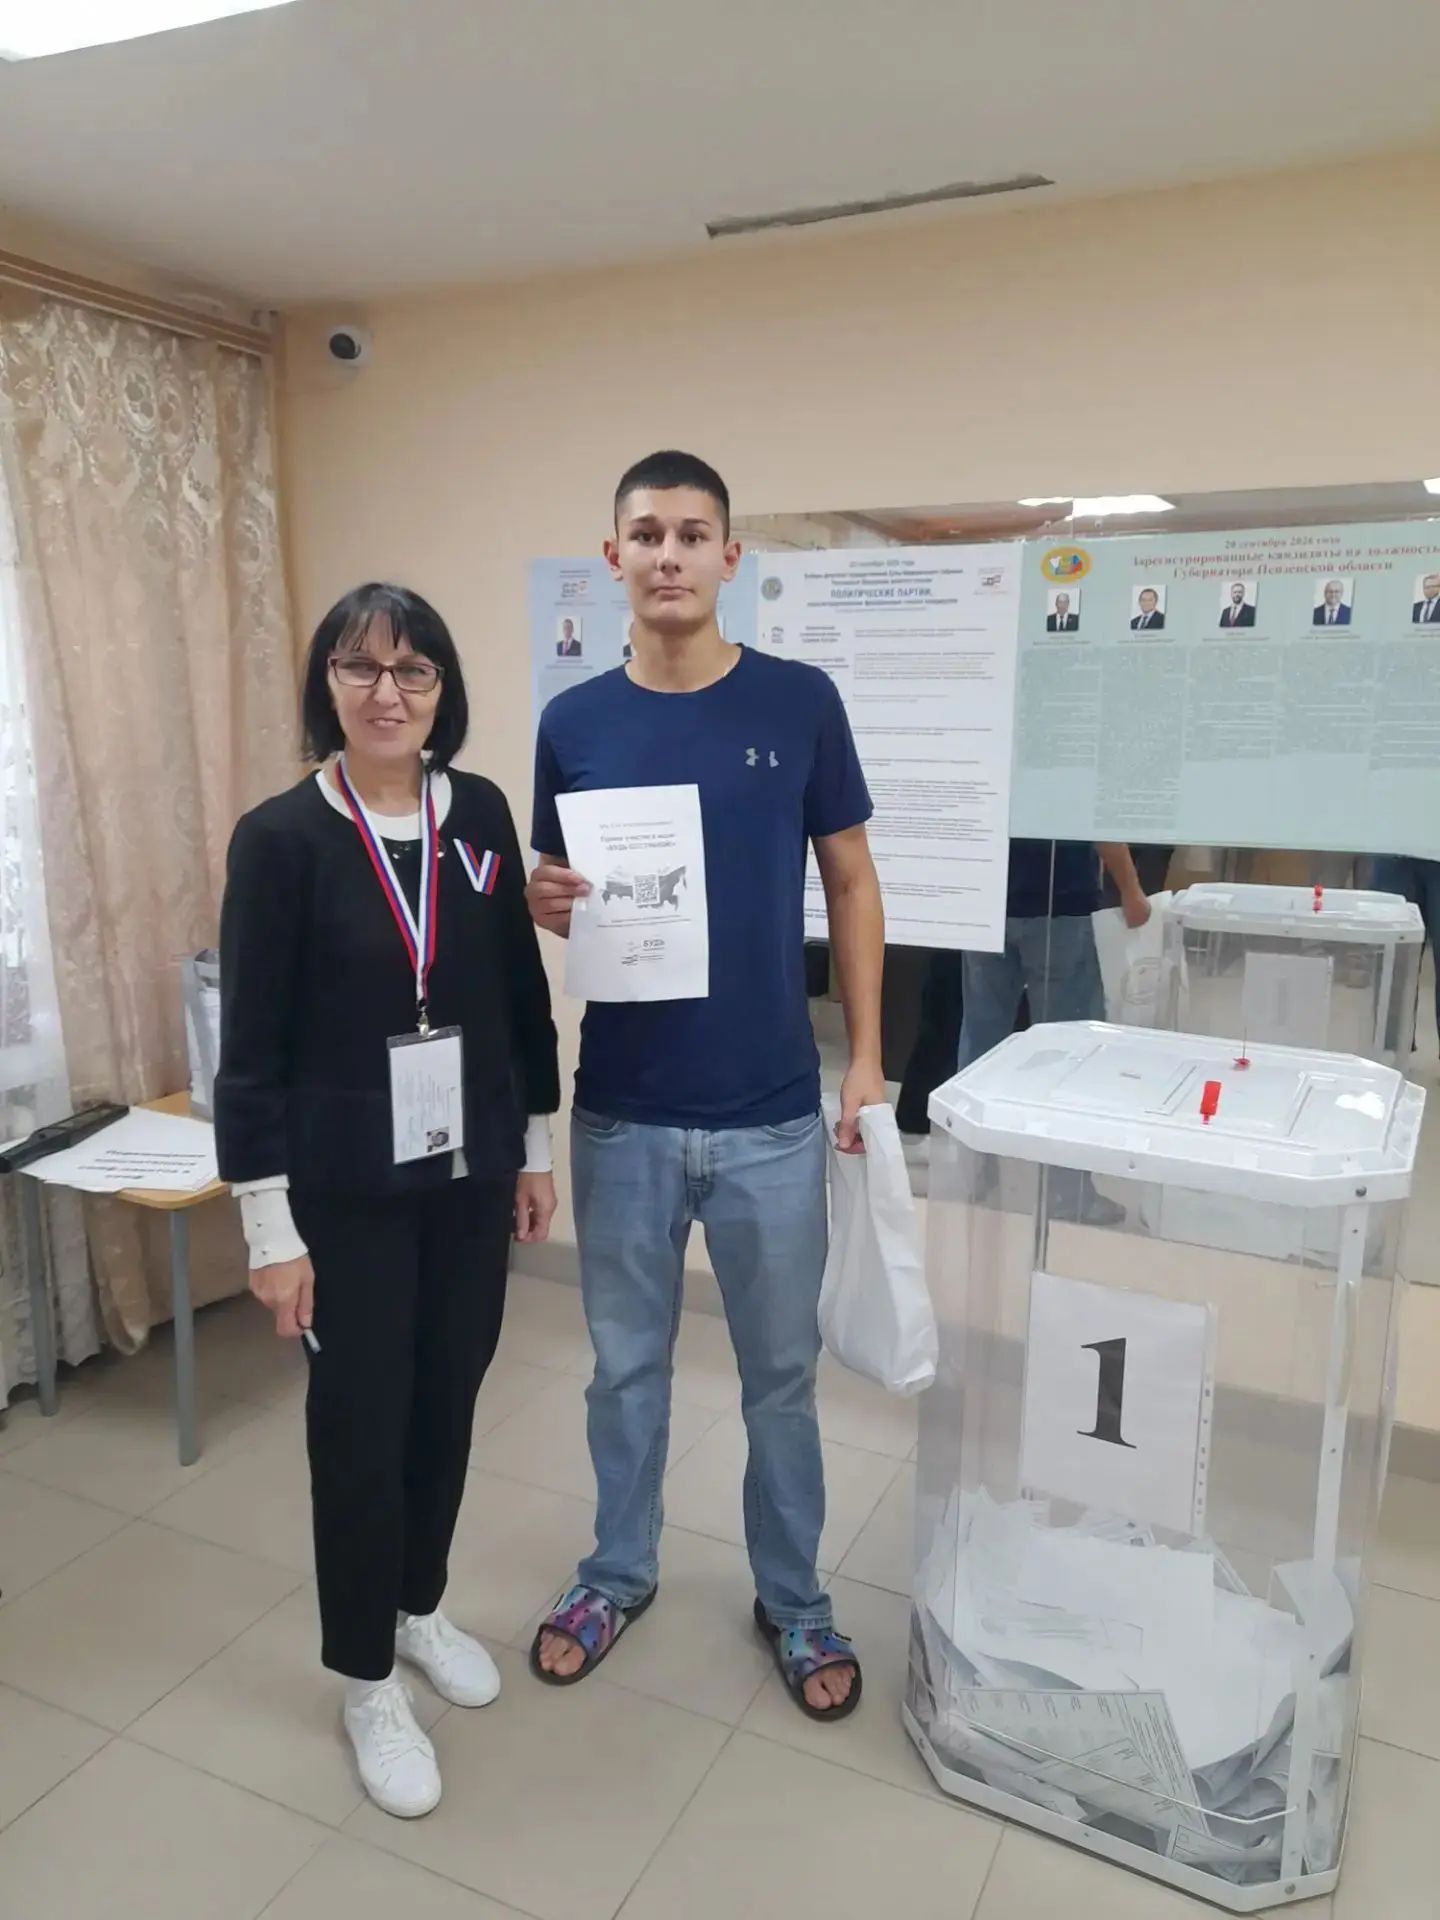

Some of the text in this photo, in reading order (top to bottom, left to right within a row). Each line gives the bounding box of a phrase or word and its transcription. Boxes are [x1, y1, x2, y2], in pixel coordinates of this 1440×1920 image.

[1345, 548, 1361, 557] на
[1338, 560, 1393, 572] области
[830, 588, 895, 598] ПОЛИТИЧЕСКИЕ
[1077, 1337, 1137, 1449] 1
